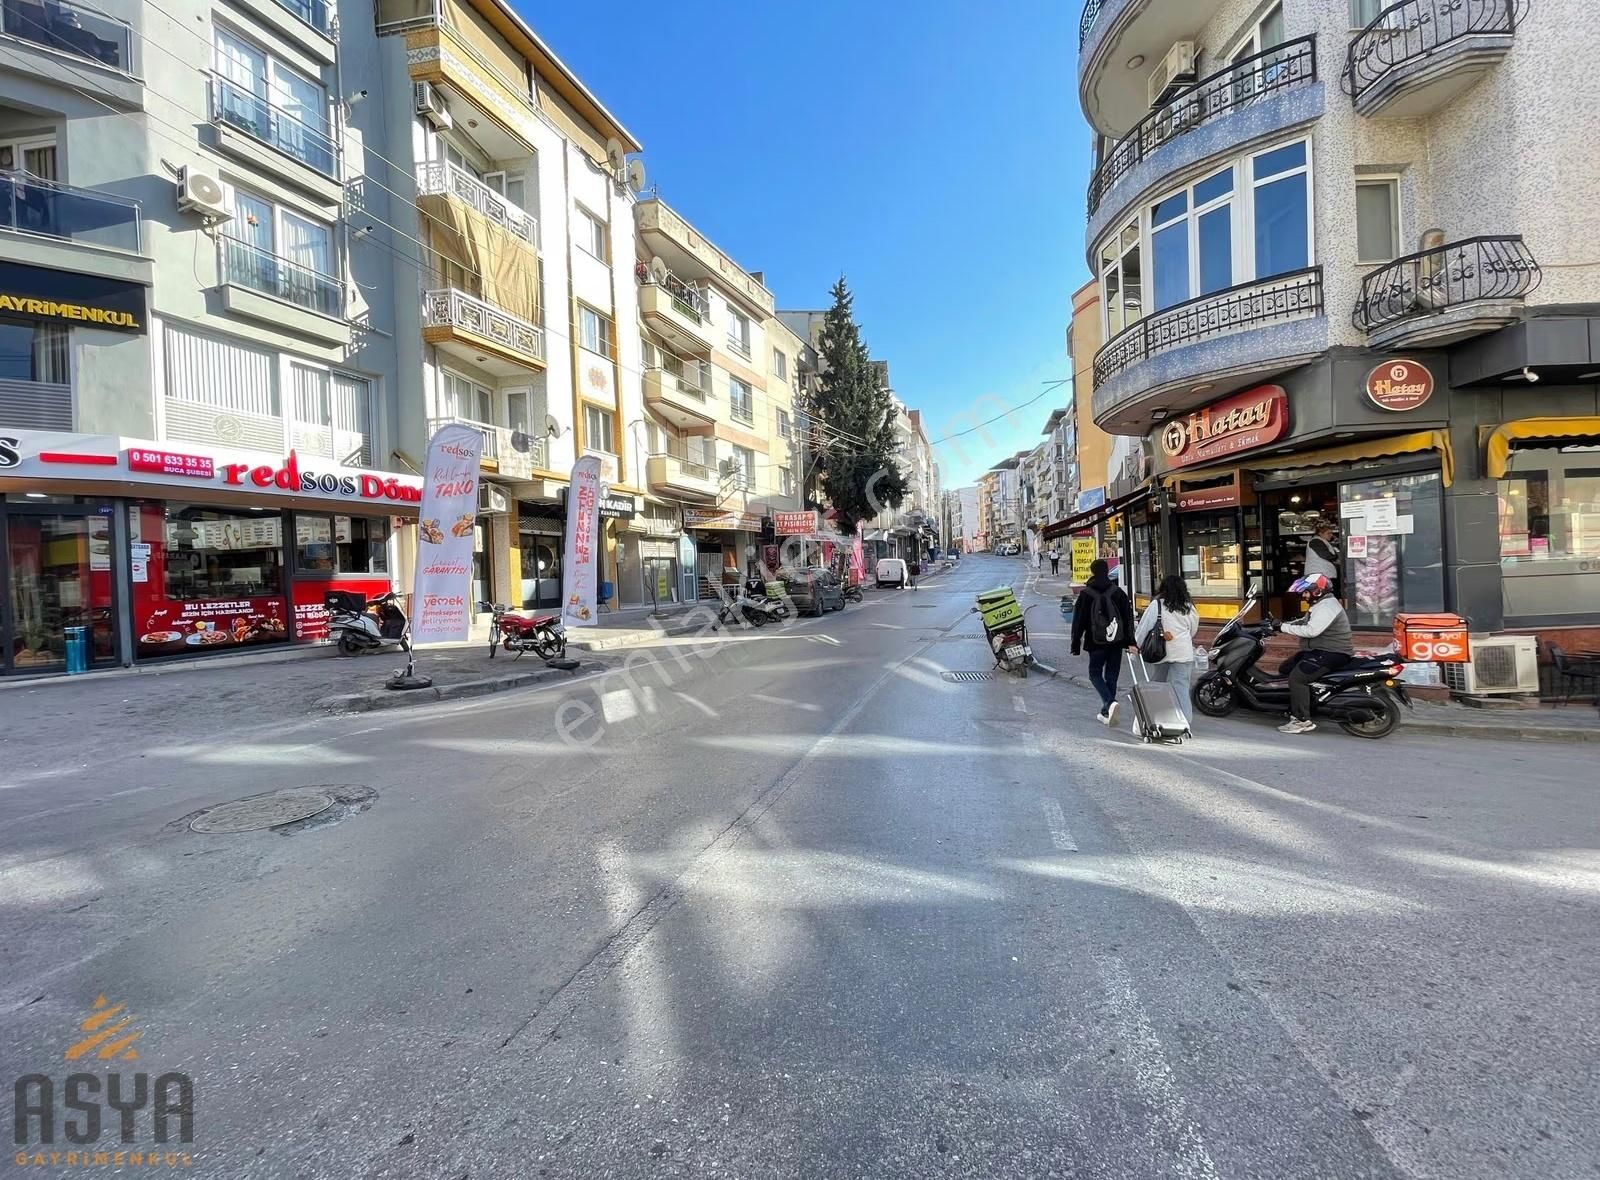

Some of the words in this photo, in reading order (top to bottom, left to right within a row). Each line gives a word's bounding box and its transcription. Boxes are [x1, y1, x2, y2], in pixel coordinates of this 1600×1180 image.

[1374, 379, 1426, 395] Hatay
[1186, 398, 1273, 444] Hatay
[441, 441, 475, 457] redsos
[133, 452, 140, 461] 0
[143, 453, 161, 464] 501
[164, 455, 183, 466] 633
[186, 458, 198, 467] 35
[200, 459, 212, 469] 35
[164, 466, 185, 474] BUCA
[222, 448, 357, 494] redsos
[435, 479, 474, 498] TAKO
[606, 500, 633, 512] KADİR
[200, 601, 251, 610] LEZZETLER
[424, 596, 464, 608] yemek
[993, 608, 1013, 620] vigo
[1411, 641, 1464, 661] go
